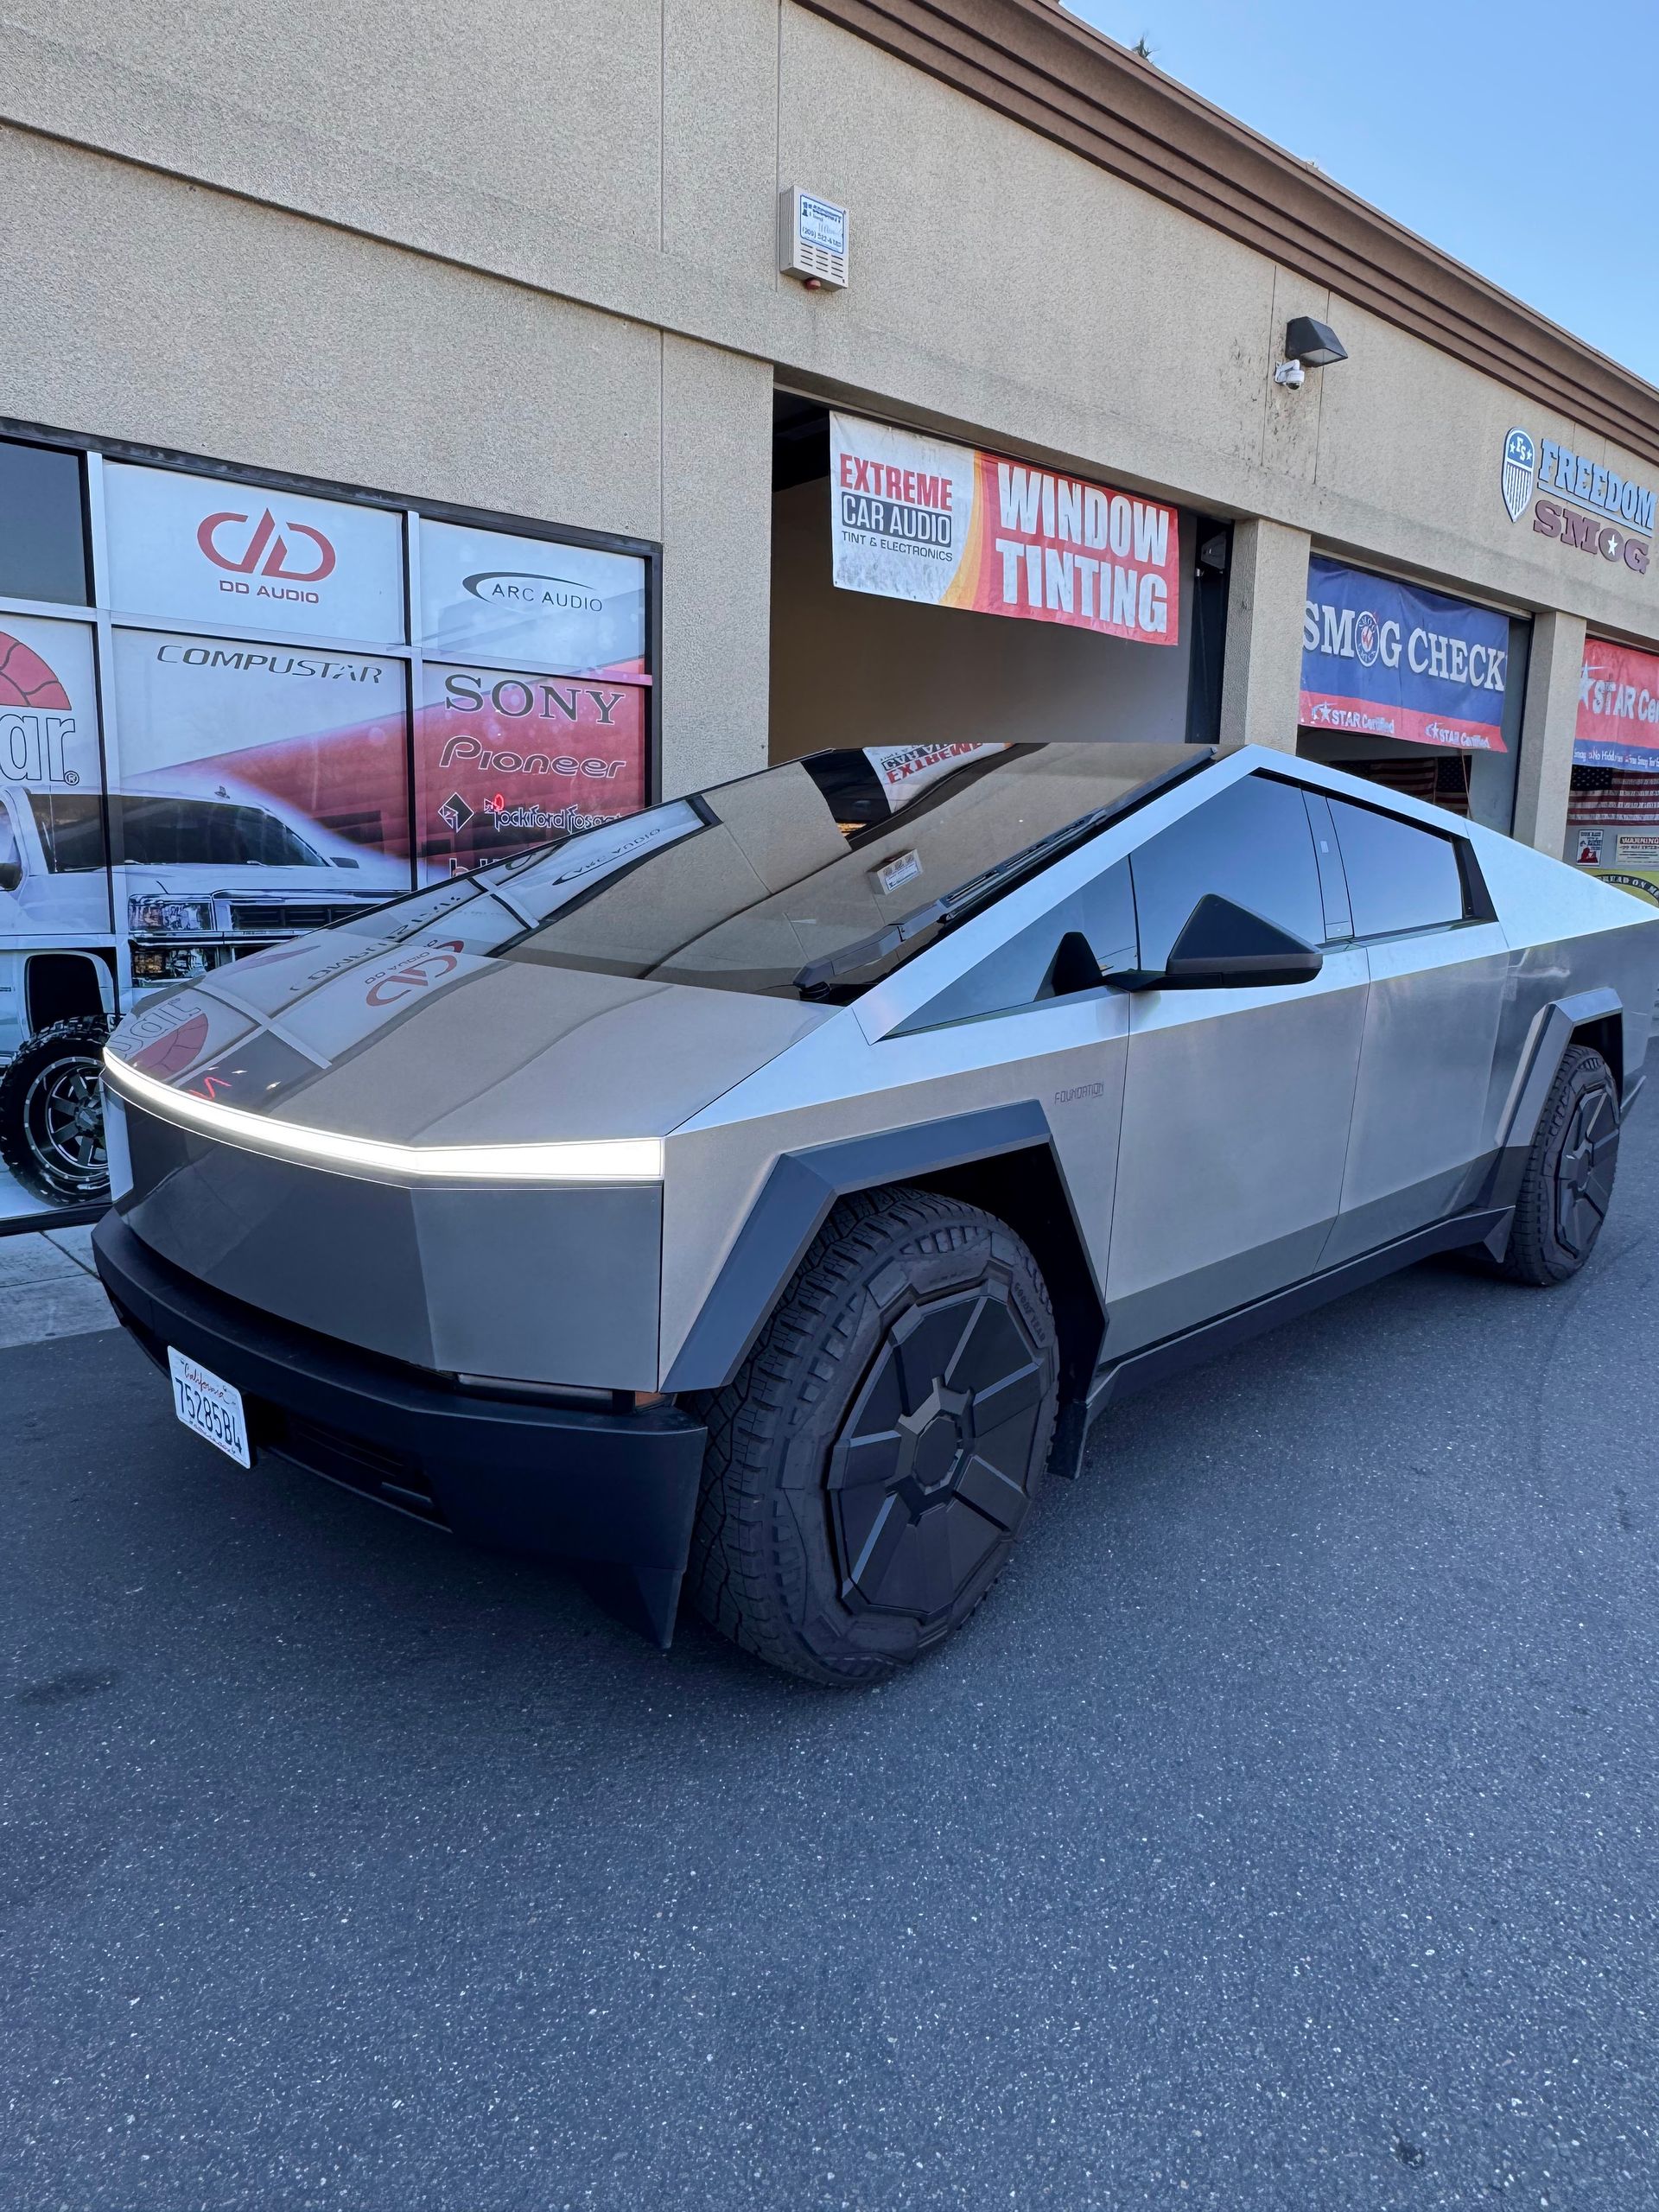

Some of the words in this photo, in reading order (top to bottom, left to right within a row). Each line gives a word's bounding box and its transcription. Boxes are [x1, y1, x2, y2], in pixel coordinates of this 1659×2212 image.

[840, 453, 952, 512] EXTREME
[1538, 439, 1657, 530] FREEDOM
[843, 495, 884, 531] CAR
[890, 505, 950, 544] AUDIO
[998, 462, 1169, 567] WINDOW
[842, 531, 867, 545] TINT
[870, 537, 877, 547] &
[880, 539, 953, 562] ELECTRONICS
[1533, 499, 1649, 575] SMOG
[219, 580, 250, 594] DD
[257, 585, 319, 603] AUDIO
[492, 583, 534, 601] ARC
[542, 592, 602, 612] AUDIO
[995, 538, 1166, 633] TINTING
[157, 645, 382, 683] COMPUSTAR
[1303, 601, 1402, 669] SMOG
[1408, 627, 1505, 691] CHECK
[445, 674, 626, 725] SONY
[1332, 710, 1362, 728] STAR
[1592, 680, 1637, 720] STAR
[439, 735, 626, 779] Pioneer
[1054, 1082, 1104, 1104] FOUNDATION
[184, 1363, 225, 1398] California
